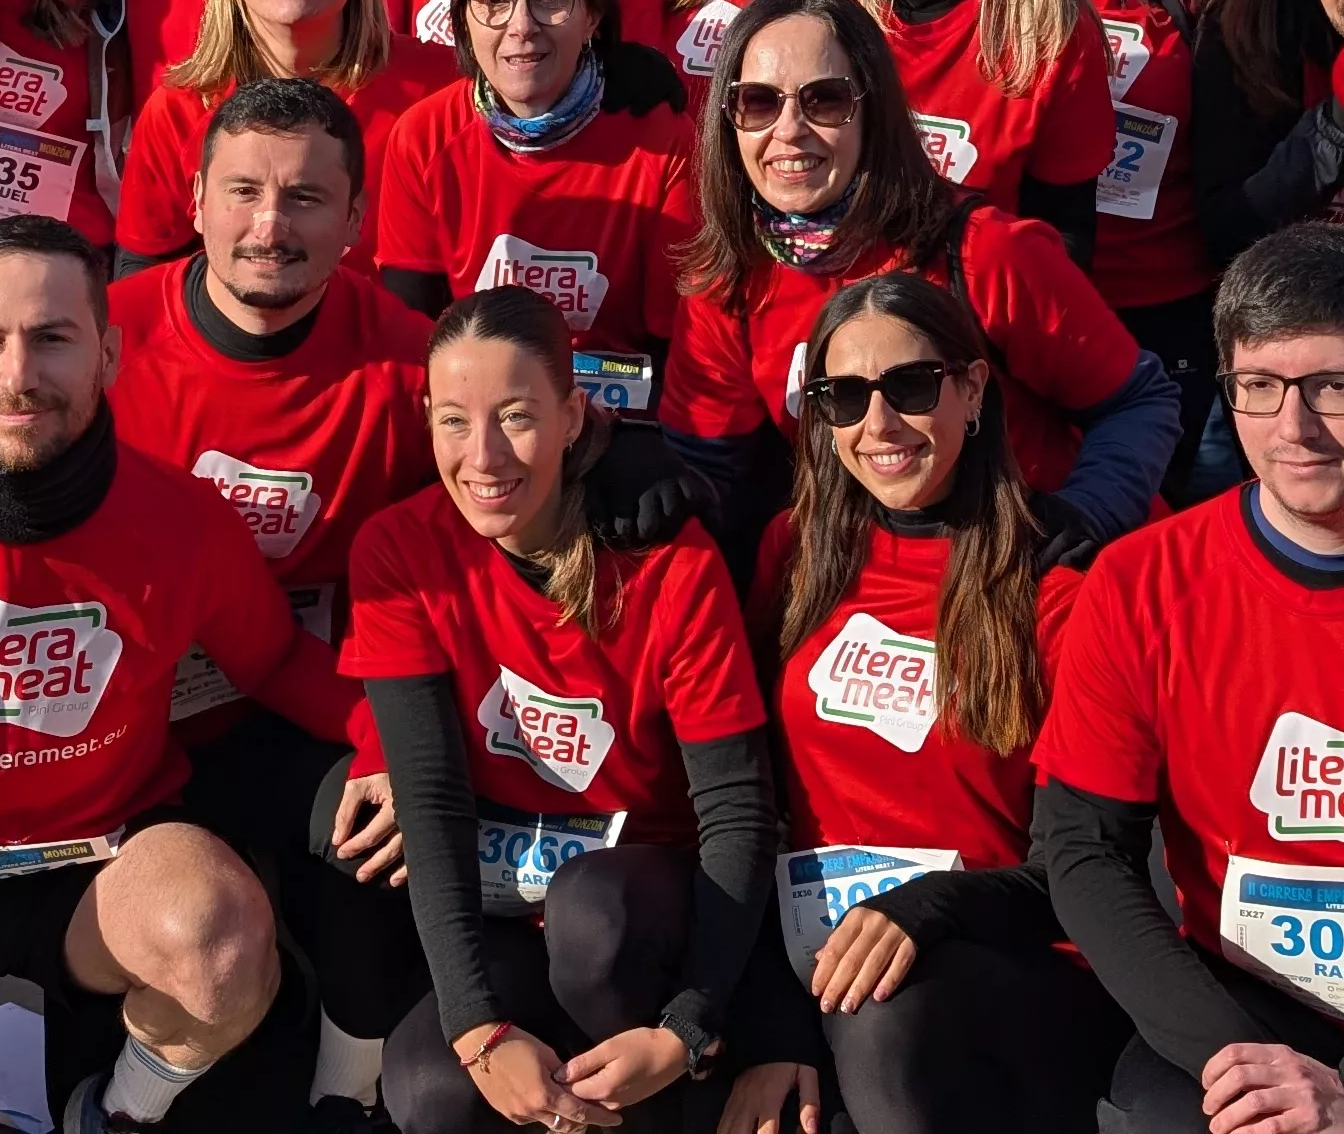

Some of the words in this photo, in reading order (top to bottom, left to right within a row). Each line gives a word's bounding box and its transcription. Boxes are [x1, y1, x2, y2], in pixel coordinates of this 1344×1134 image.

[544, 284, 588, 313] eat
[577, 382, 628, 407] 79
[218, 478, 288, 509] tera
[246, 505, 299, 535] eat
[842, 676, 935, 716] meat
[52, 701, 89, 715] Group
[560, 766, 588, 778] Group
[43, 843, 88, 860] MONZÓN
[502, 870, 552, 885] CLARA
[1259, 882, 1312, 901] CARRERA
[1239, 909, 1265, 920] EX27
